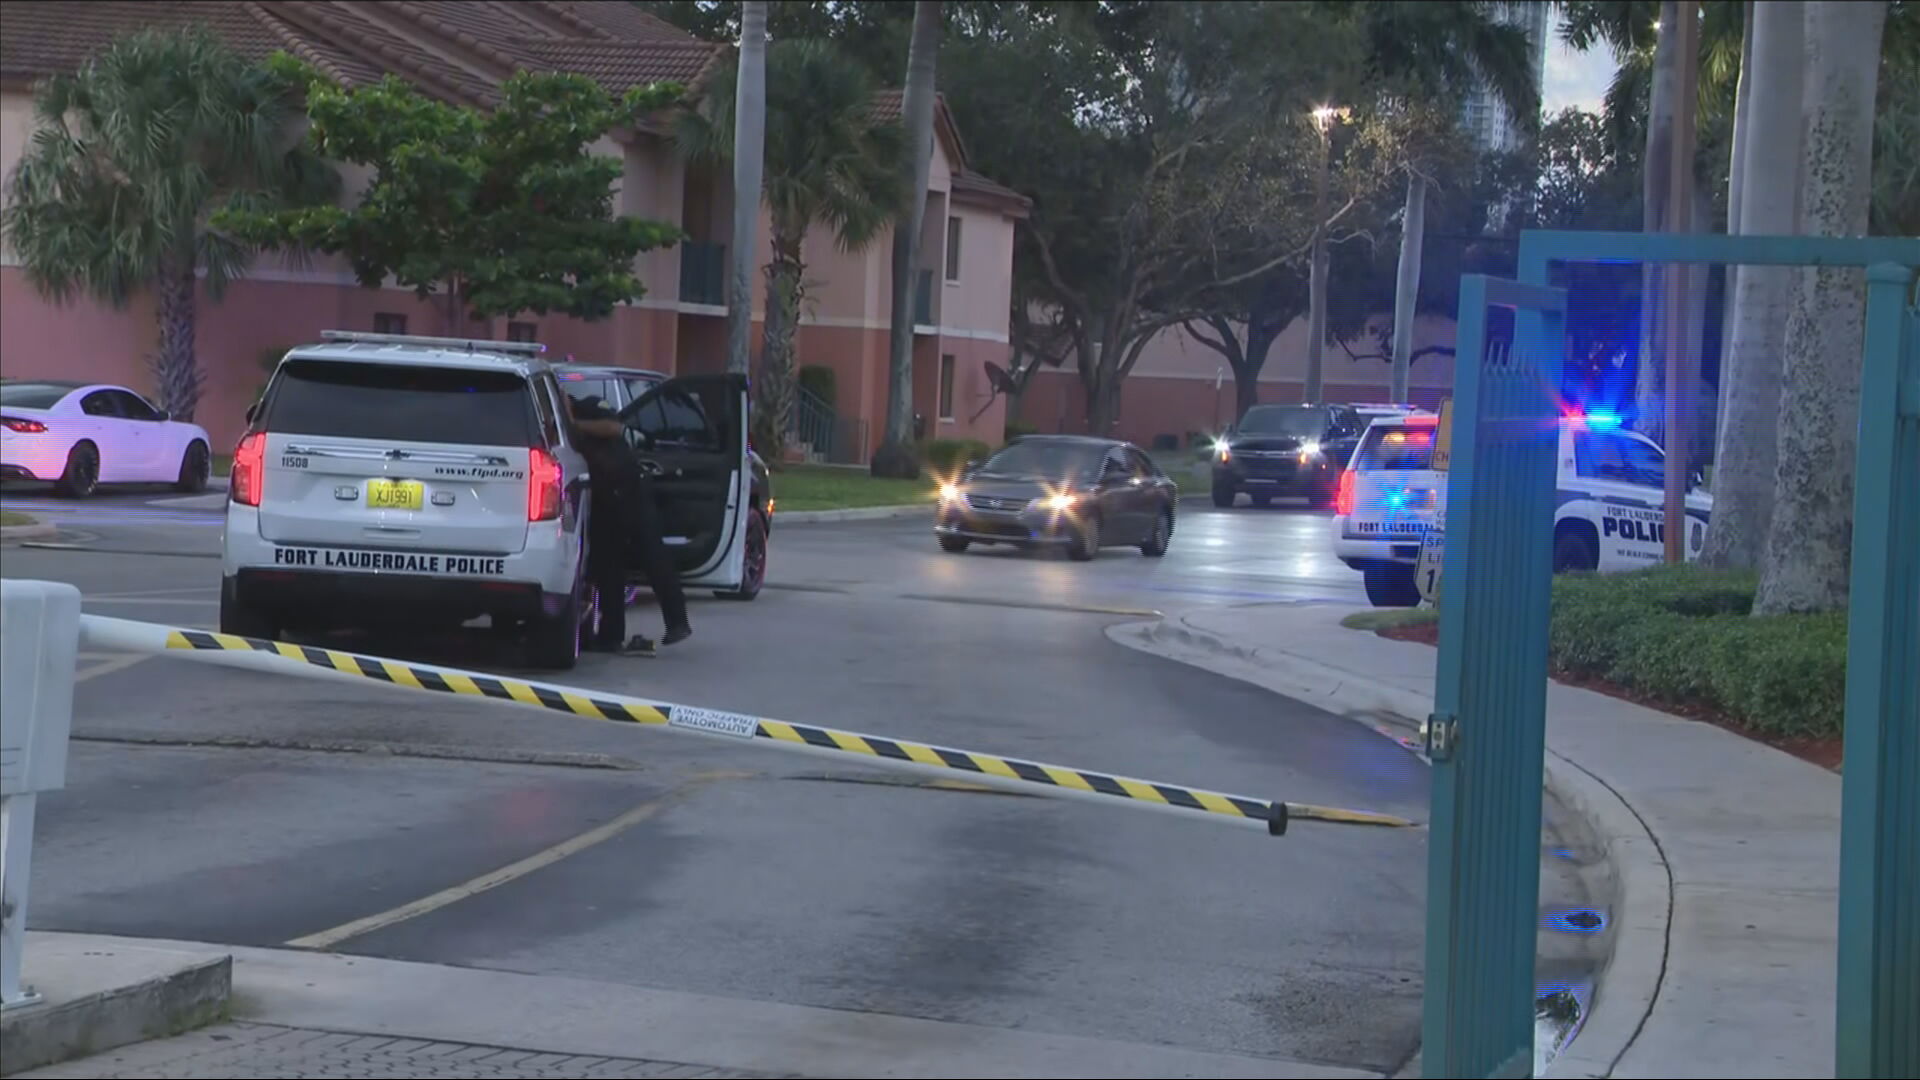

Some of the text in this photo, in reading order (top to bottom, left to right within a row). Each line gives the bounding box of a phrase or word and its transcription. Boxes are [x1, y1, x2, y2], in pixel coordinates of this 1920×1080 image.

[282, 457, 309, 468] 11508
[435, 467, 524, 480] www.flpd.org
[1629, 510, 1664, 522] LAUDERD
[1602, 516, 1664, 543] POLI
[275, 548, 504, 574] FORT LAUDERDALE POLICE
[676, 714, 748, 733] AUTOMOTIVE
[707, 713, 753, 726] TRAFFIC
